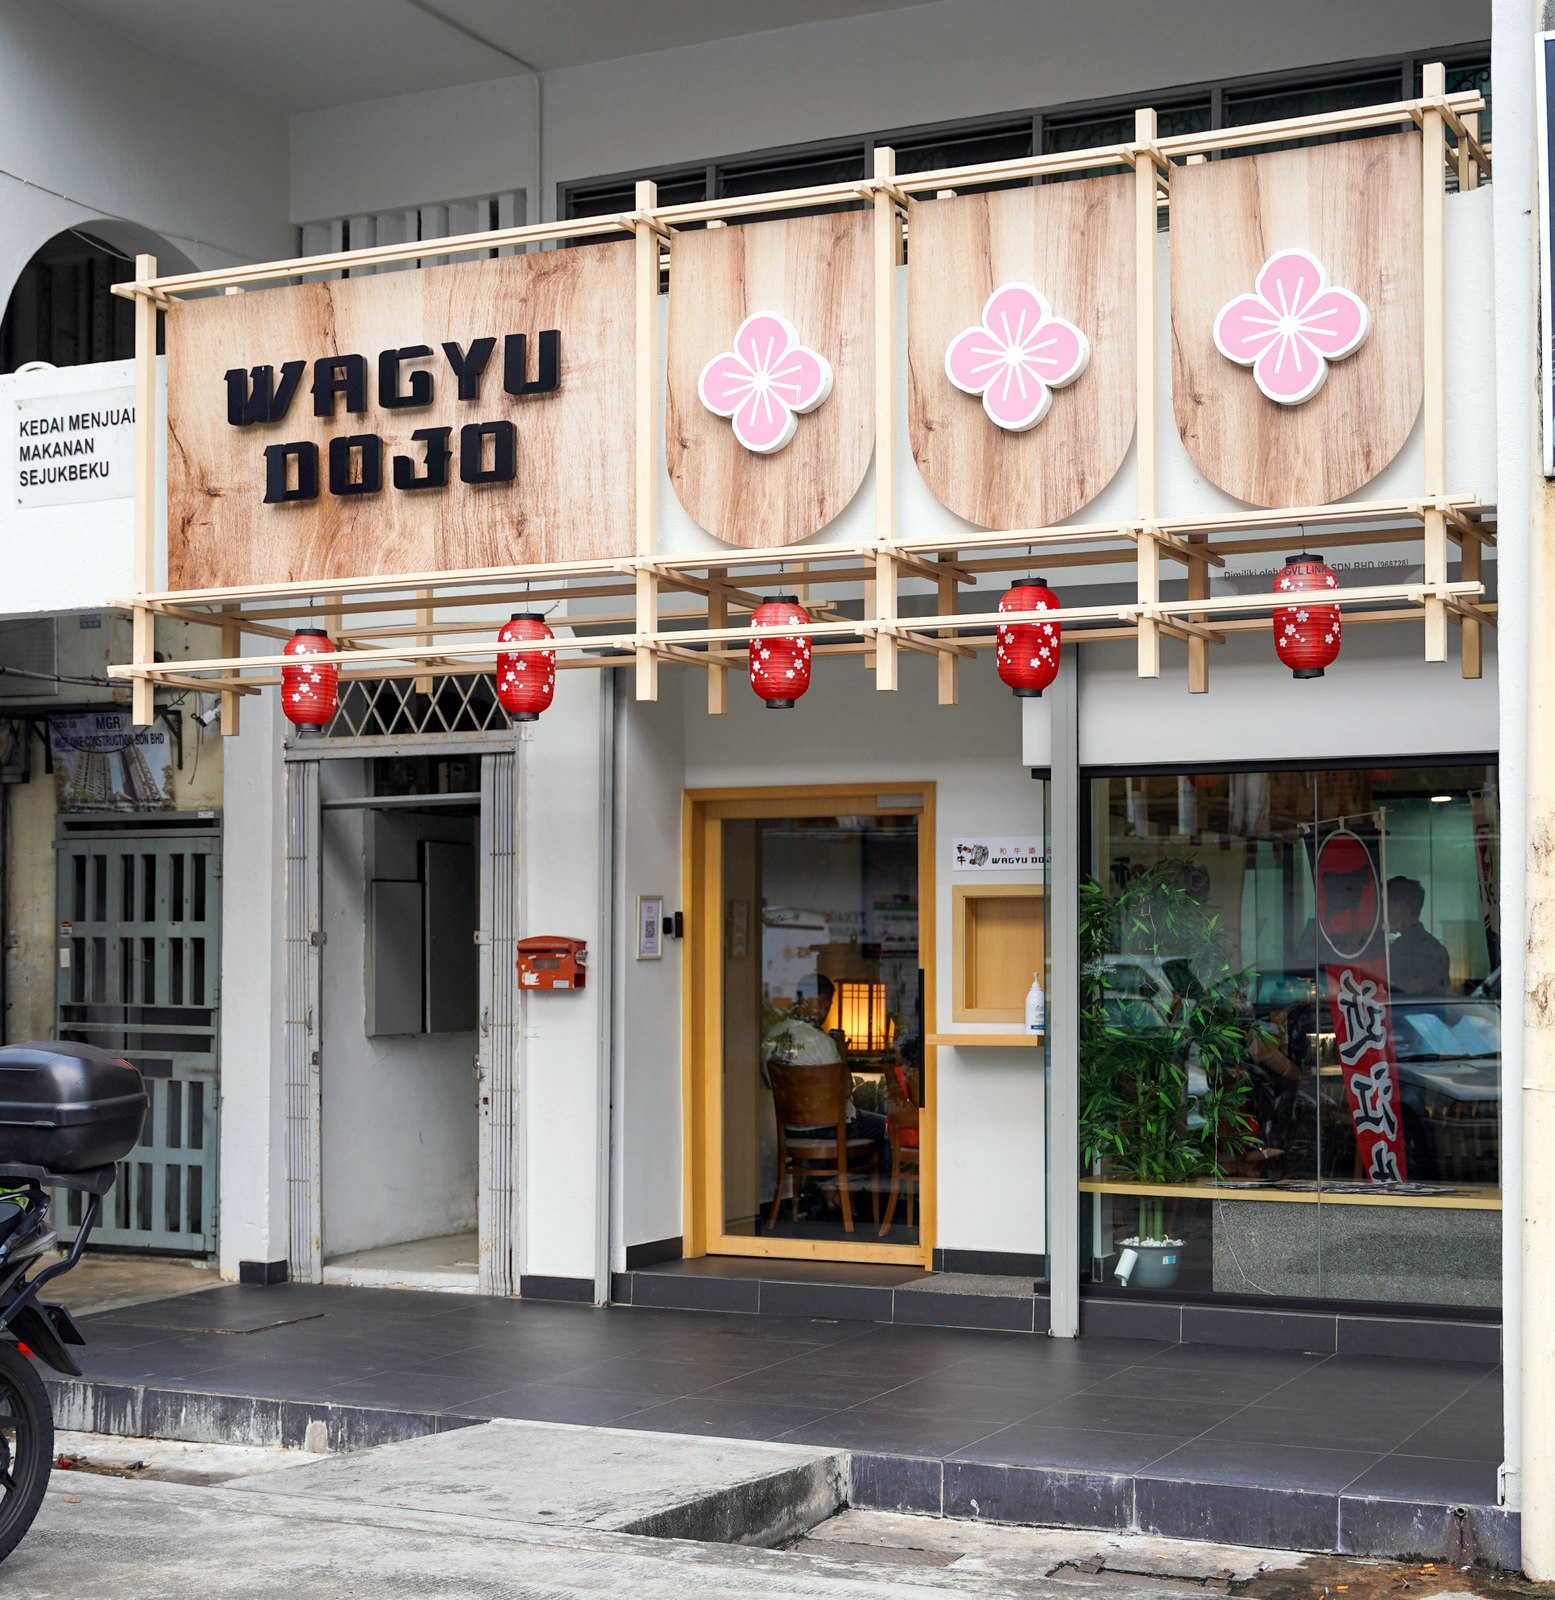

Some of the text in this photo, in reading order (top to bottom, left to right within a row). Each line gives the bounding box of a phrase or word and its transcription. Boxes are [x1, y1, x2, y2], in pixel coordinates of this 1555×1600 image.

[224, 329, 561, 426] WAGYU
[20, 416, 64, 437] KEDAI
[20, 437, 94, 462] MAKANAN
[263, 420, 517, 503] DOJO
[20, 461, 109, 487] SEJUKBEKU
[1224, 569, 1258, 580] Dimiliki
[1284, 565, 1304, 576] GVL
[1306, 564, 1328, 575] LINK
[1331, 562, 1351, 572] SDN
[1354, 561, 1375, 570] BHD
[95, 715, 121, 729] MGR
[135, 733, 149, 745] SDN
[151, 732, 164, 745] BHD
[991, 856, 1028, 865] WAGYU
